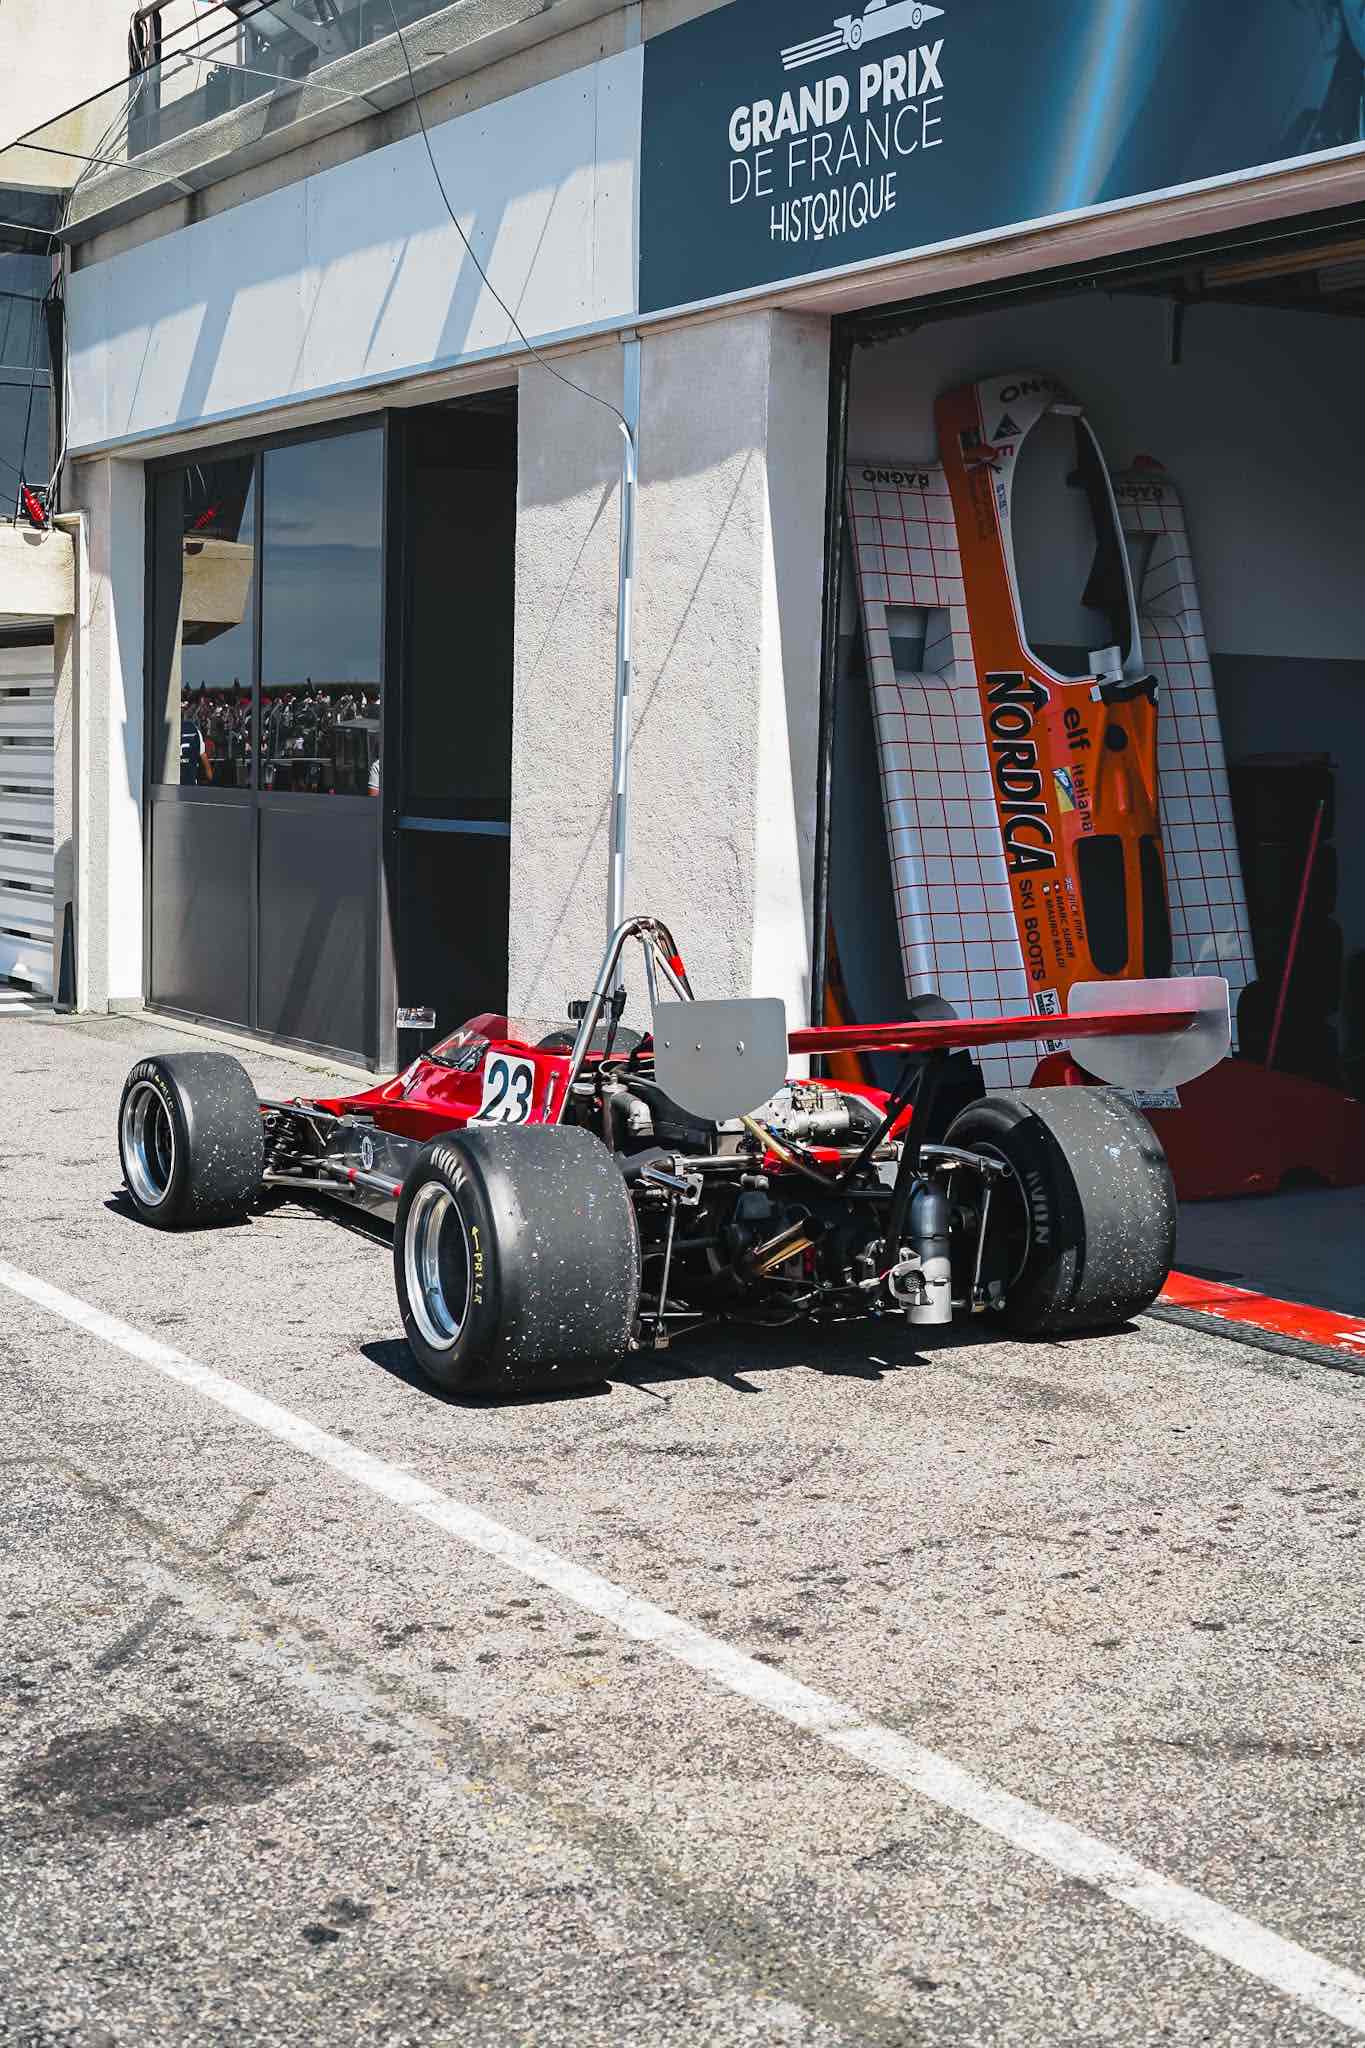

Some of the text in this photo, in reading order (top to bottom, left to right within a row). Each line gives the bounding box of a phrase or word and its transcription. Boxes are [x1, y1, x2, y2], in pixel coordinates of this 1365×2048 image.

[729, 39, 944, 152] GRAND PRIX
[730, 96, 943, 204] DE FRANCE
[770, 171, 896, 242] HISTORIQUE
[863, 469, 930, 488] RAGNO
[1064, 707, 1091, 752] elf
[985, 671, 1057, 873] NORDICA
[1072, 764, 1094, 833] italiana
[1020, 880, 1046, 981] SKI BOOTS
[480, 1059, 533, 1124] 23
